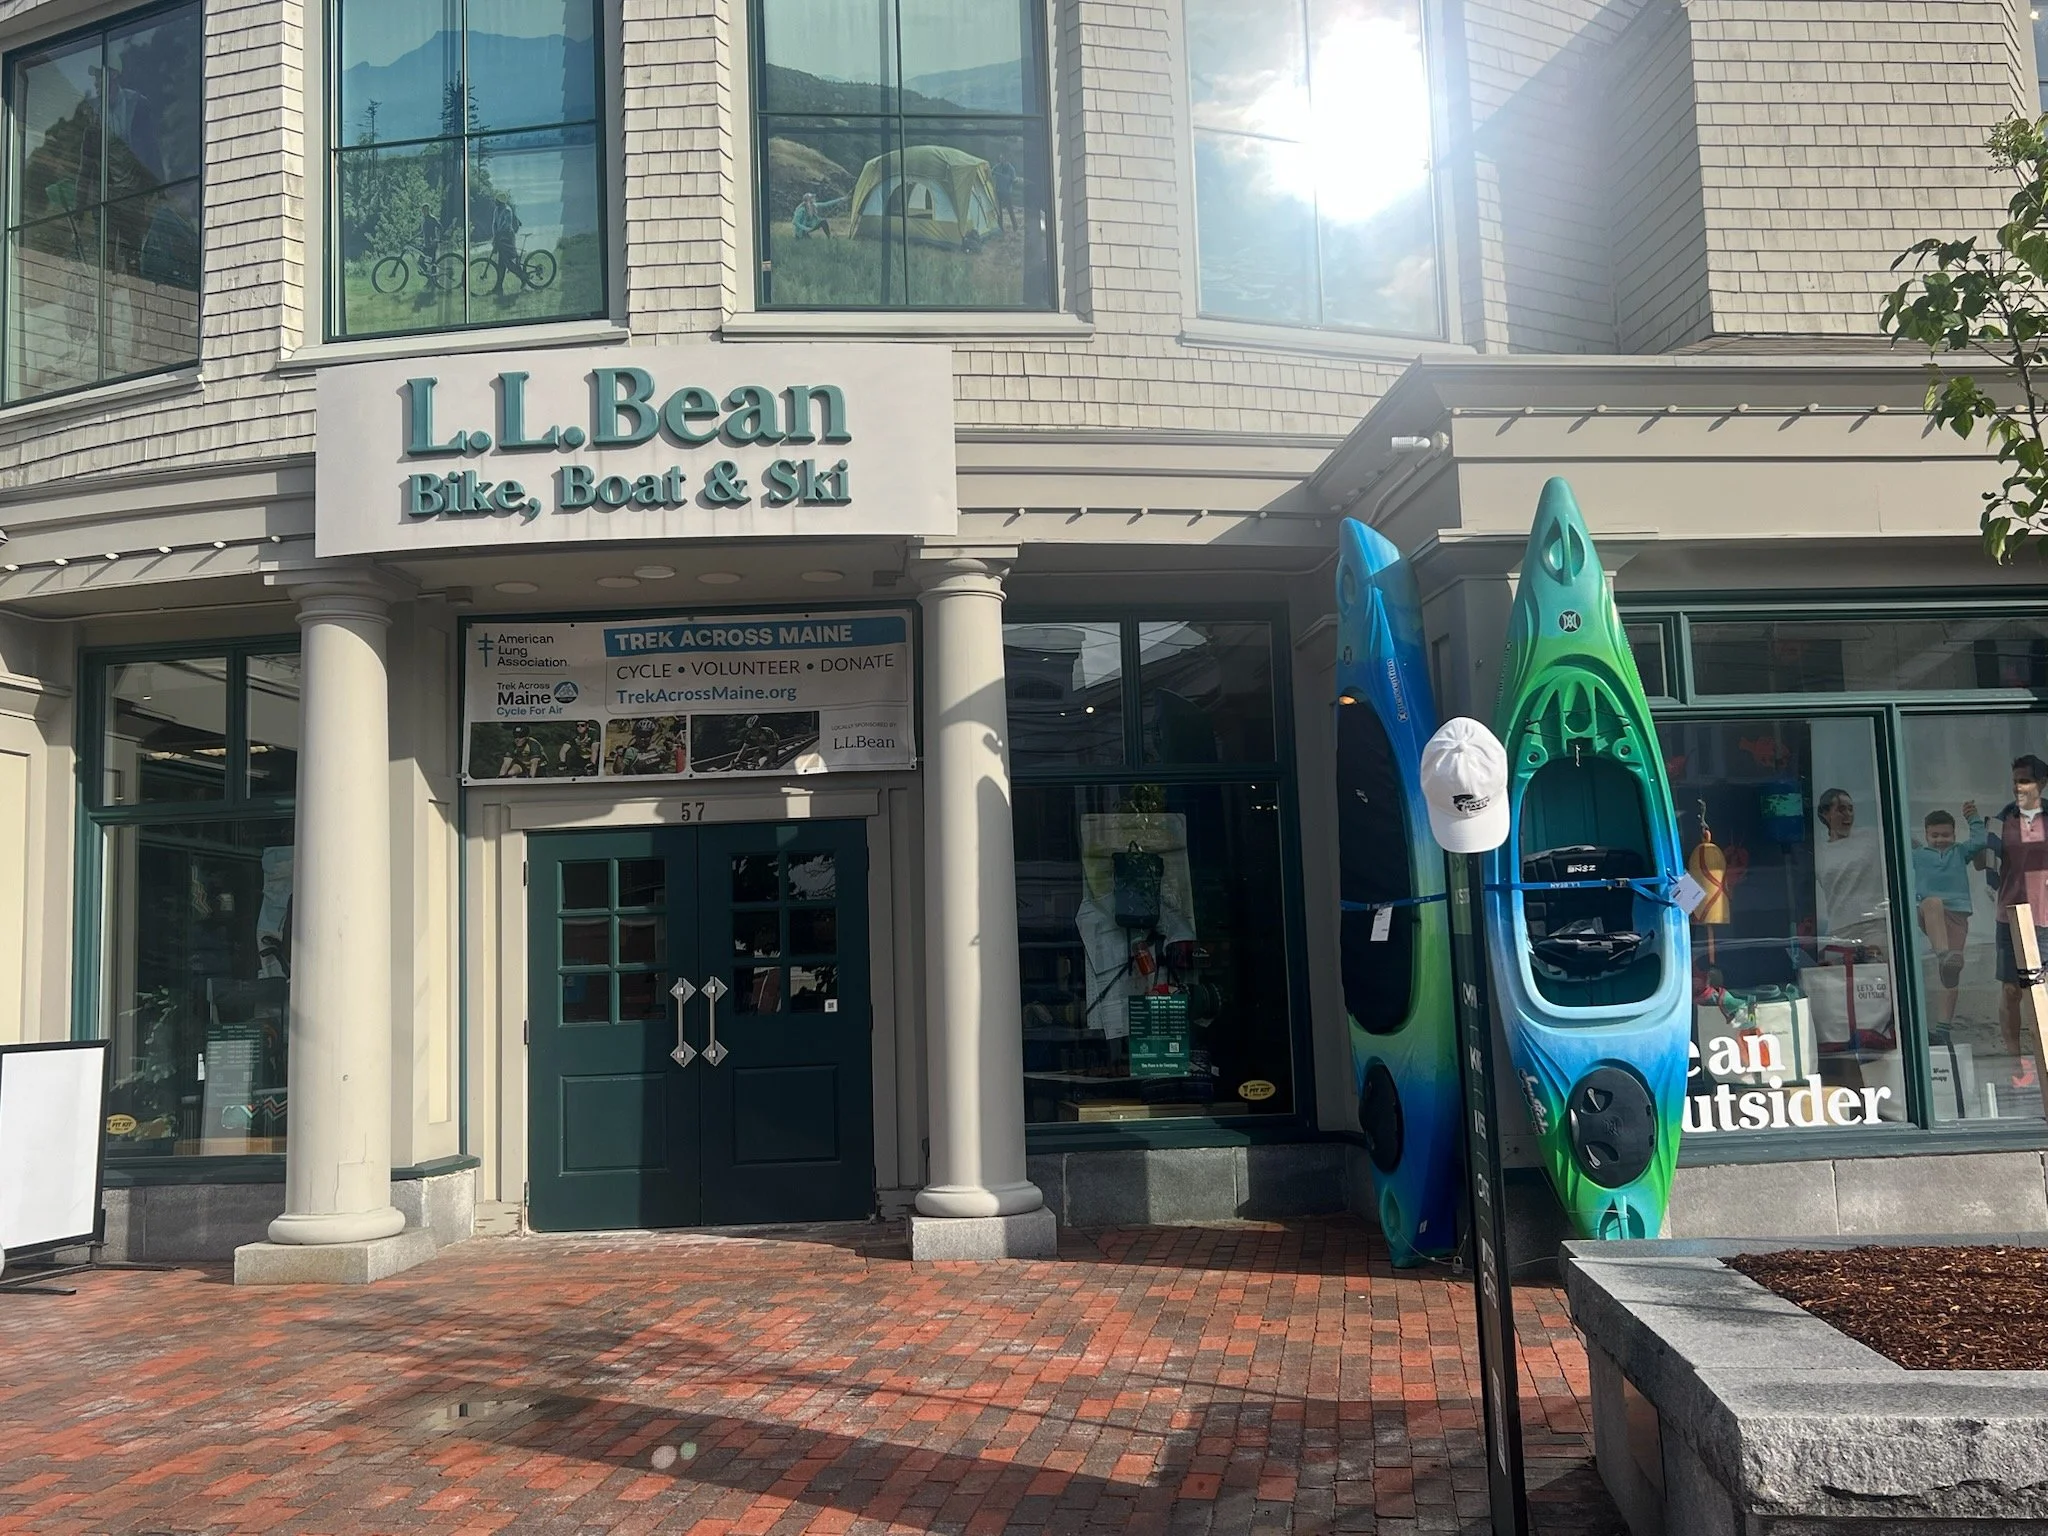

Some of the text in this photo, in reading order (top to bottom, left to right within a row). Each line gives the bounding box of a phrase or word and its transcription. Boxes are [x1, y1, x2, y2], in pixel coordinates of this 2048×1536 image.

[406, 366, 852, 455] L.L.Bean
[408, 459, 851, 525] Bike, Boat & Ski
[498, 633, 554, 644] American
[614, 625, 853, 650] TREK ACROSS MAINE
[498, 646, 528, 657] Lung
[616, 653, 894, 680] CYCLE VOLUNTEER DONATE
[497, 681, 550, 690] Trek Across
[497, 691, 551, 705] Maine
[616, 685, 797, 704] TrekAcrossMaine.org
[496, 705, 564, 717] Cycle For Air
[831, 723, 854, 731] LOCALLY
[833, 735, 895, 750] L.L.Bean
[681, 802, 705, 821] 57
[1681, 1074, 1891, 1133] utsider
